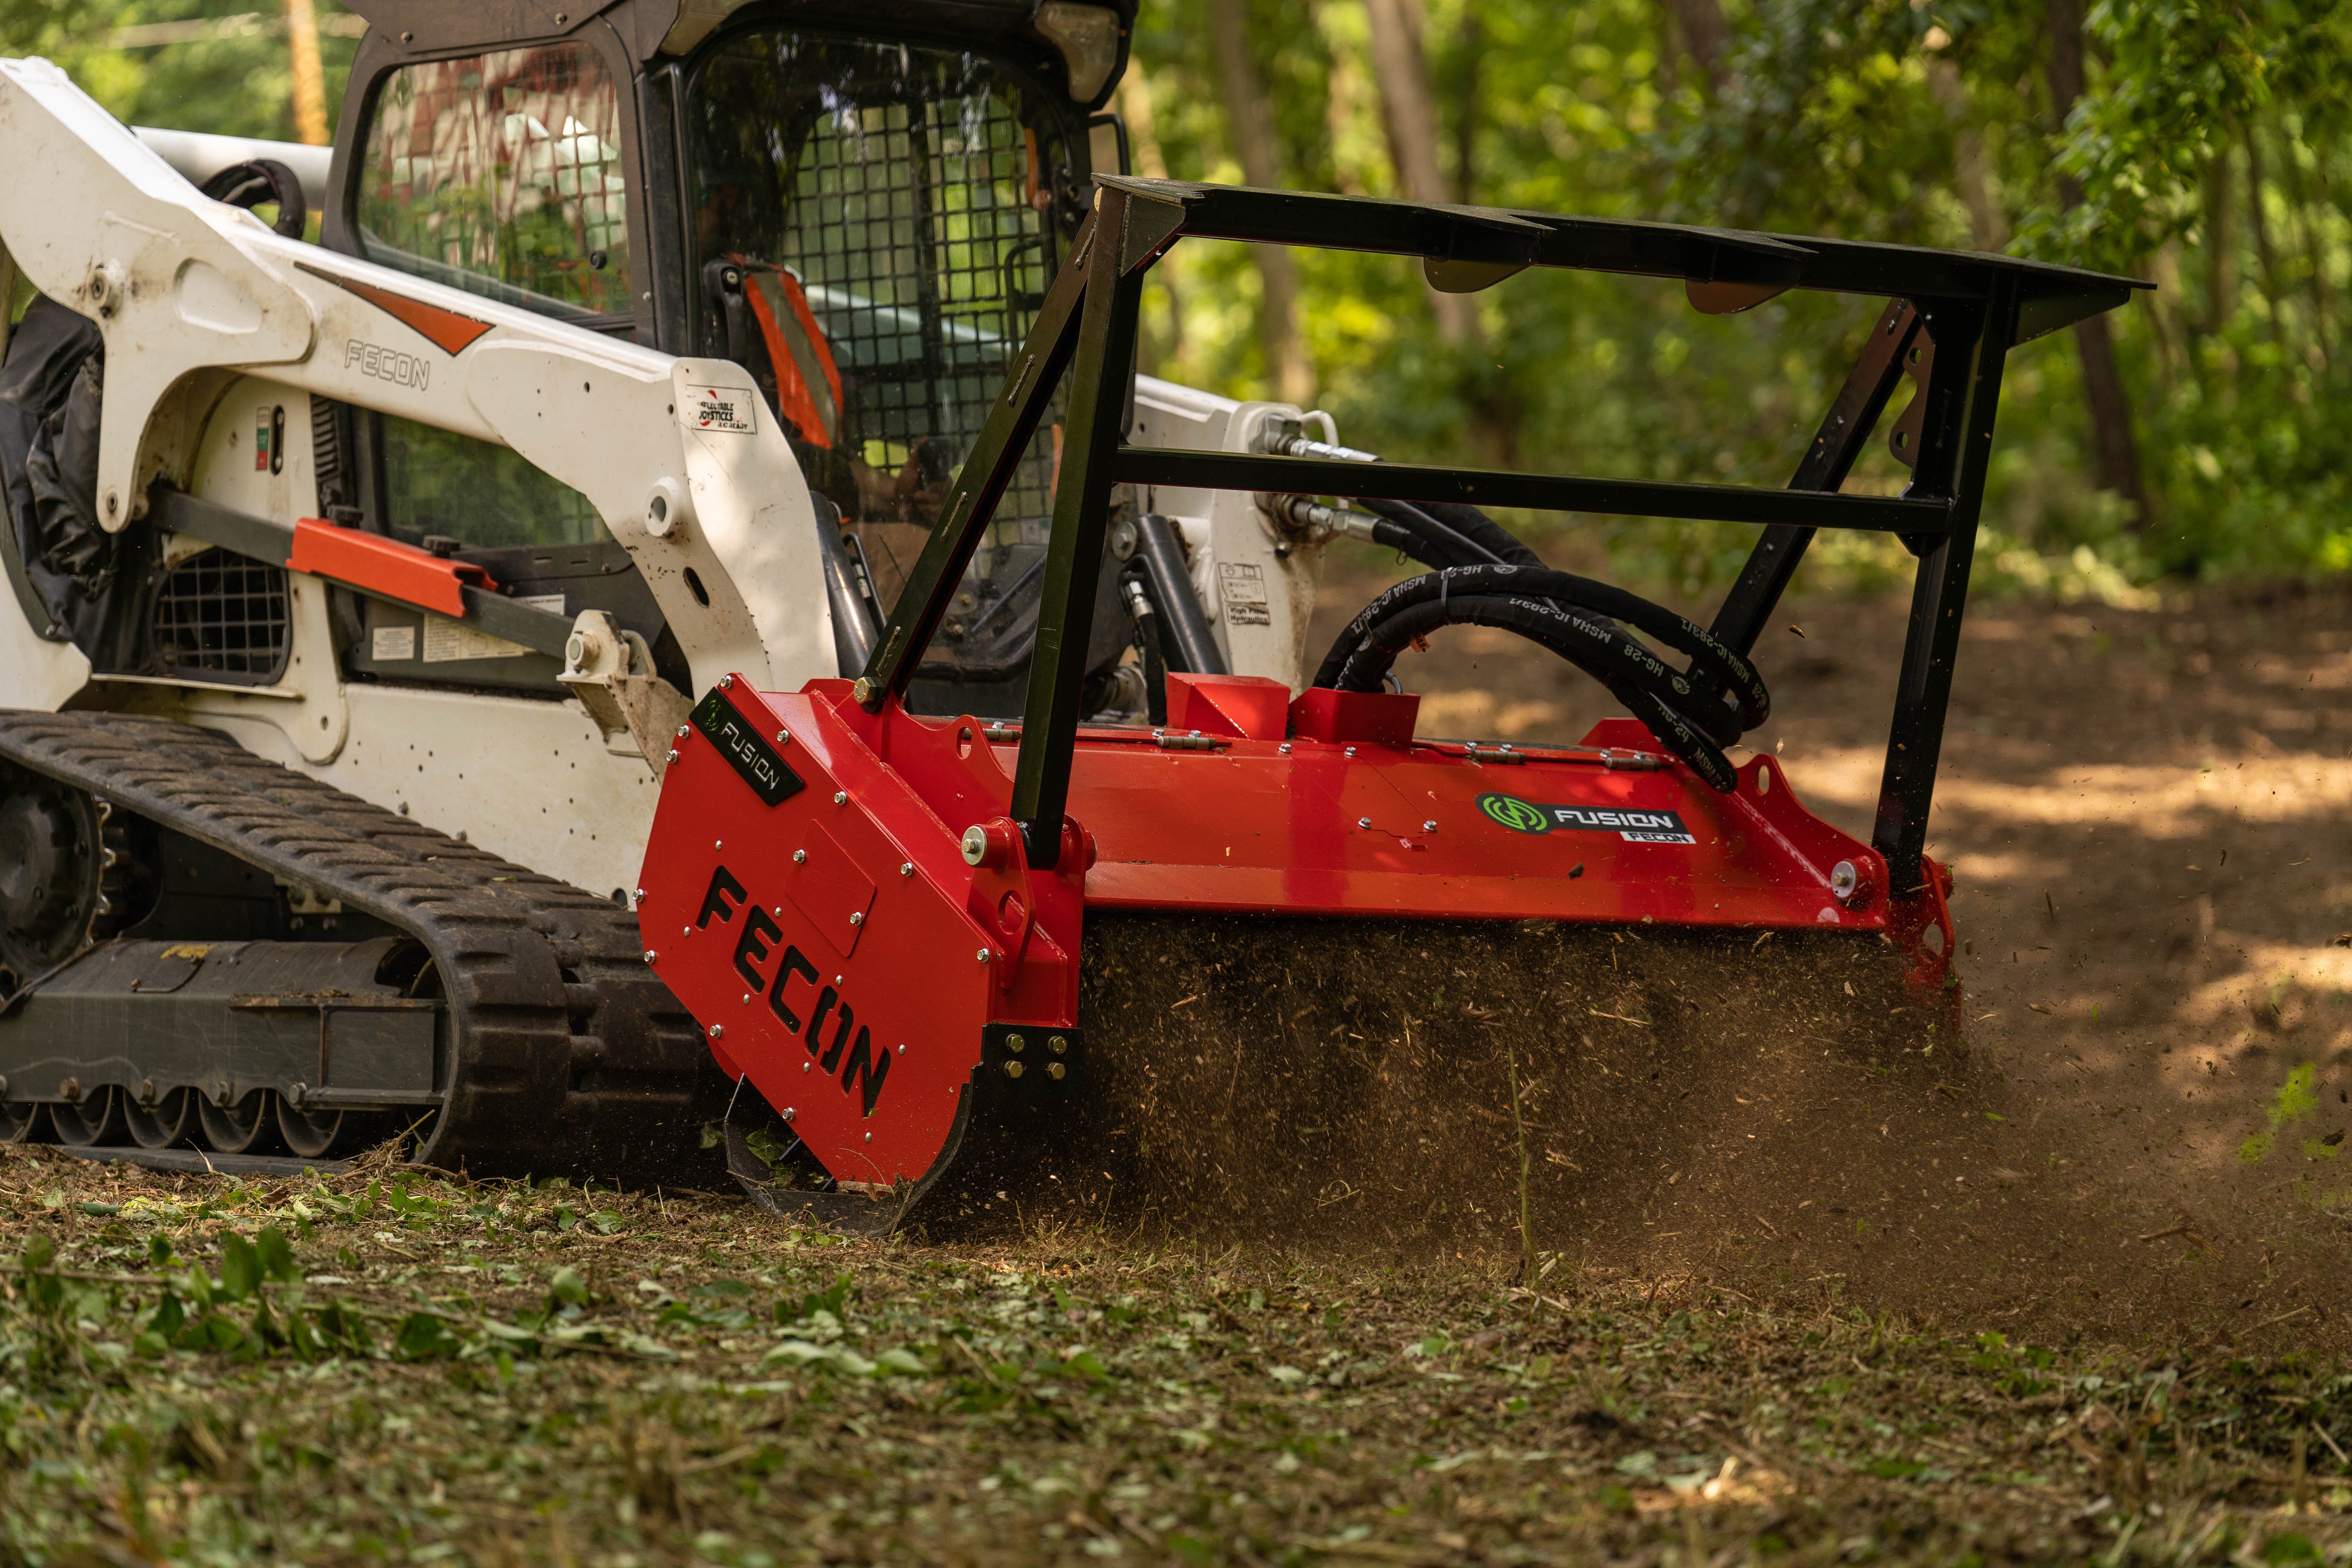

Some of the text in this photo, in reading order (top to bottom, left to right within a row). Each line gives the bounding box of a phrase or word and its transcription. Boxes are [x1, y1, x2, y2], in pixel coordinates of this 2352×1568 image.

[344, 339, 430, 391] FECON
[699, 410, 733, 421] JOYSTICKS
[1393, 575, 1426, 597] MSHA
[1572, 616, 1612, 644] MSHA
[1624, 644, 1664, 677] HG-28
[1728, 652, 1750, 683] MSHA
[720, 720, 780, 791] FUSION
[1693, 747, 1716, 778] MSHA
[1554, 809, 1674, 829] FUSION
[1629, 832, 1690, 843] FECON
[695, 865, 891, 1118] FECON
